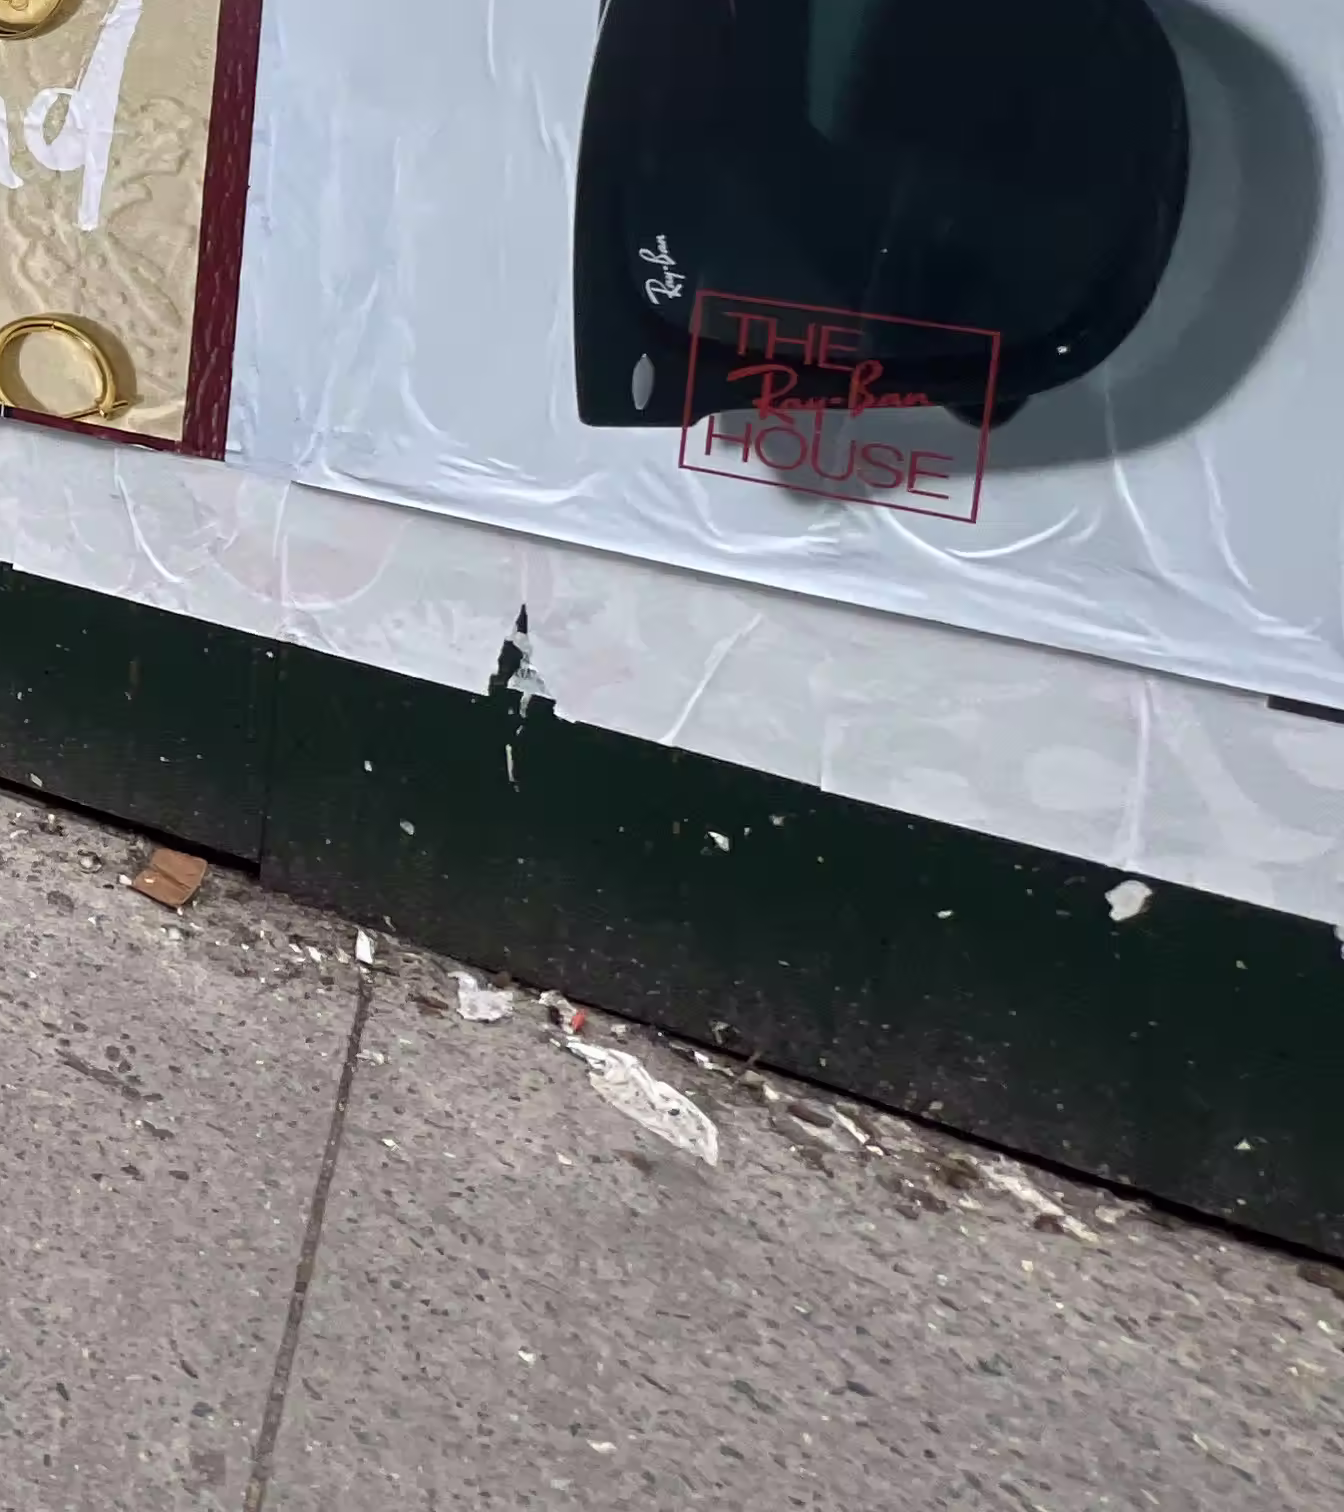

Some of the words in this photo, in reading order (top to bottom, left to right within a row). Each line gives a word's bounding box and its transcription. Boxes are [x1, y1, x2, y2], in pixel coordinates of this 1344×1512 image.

[639, 234, 686, 305] Ray-Ban
[722, 311, 866, 372] THE
[726, 359, 936, 426] Ray-Ban
[704, 414, 954, 500] HOUSE
